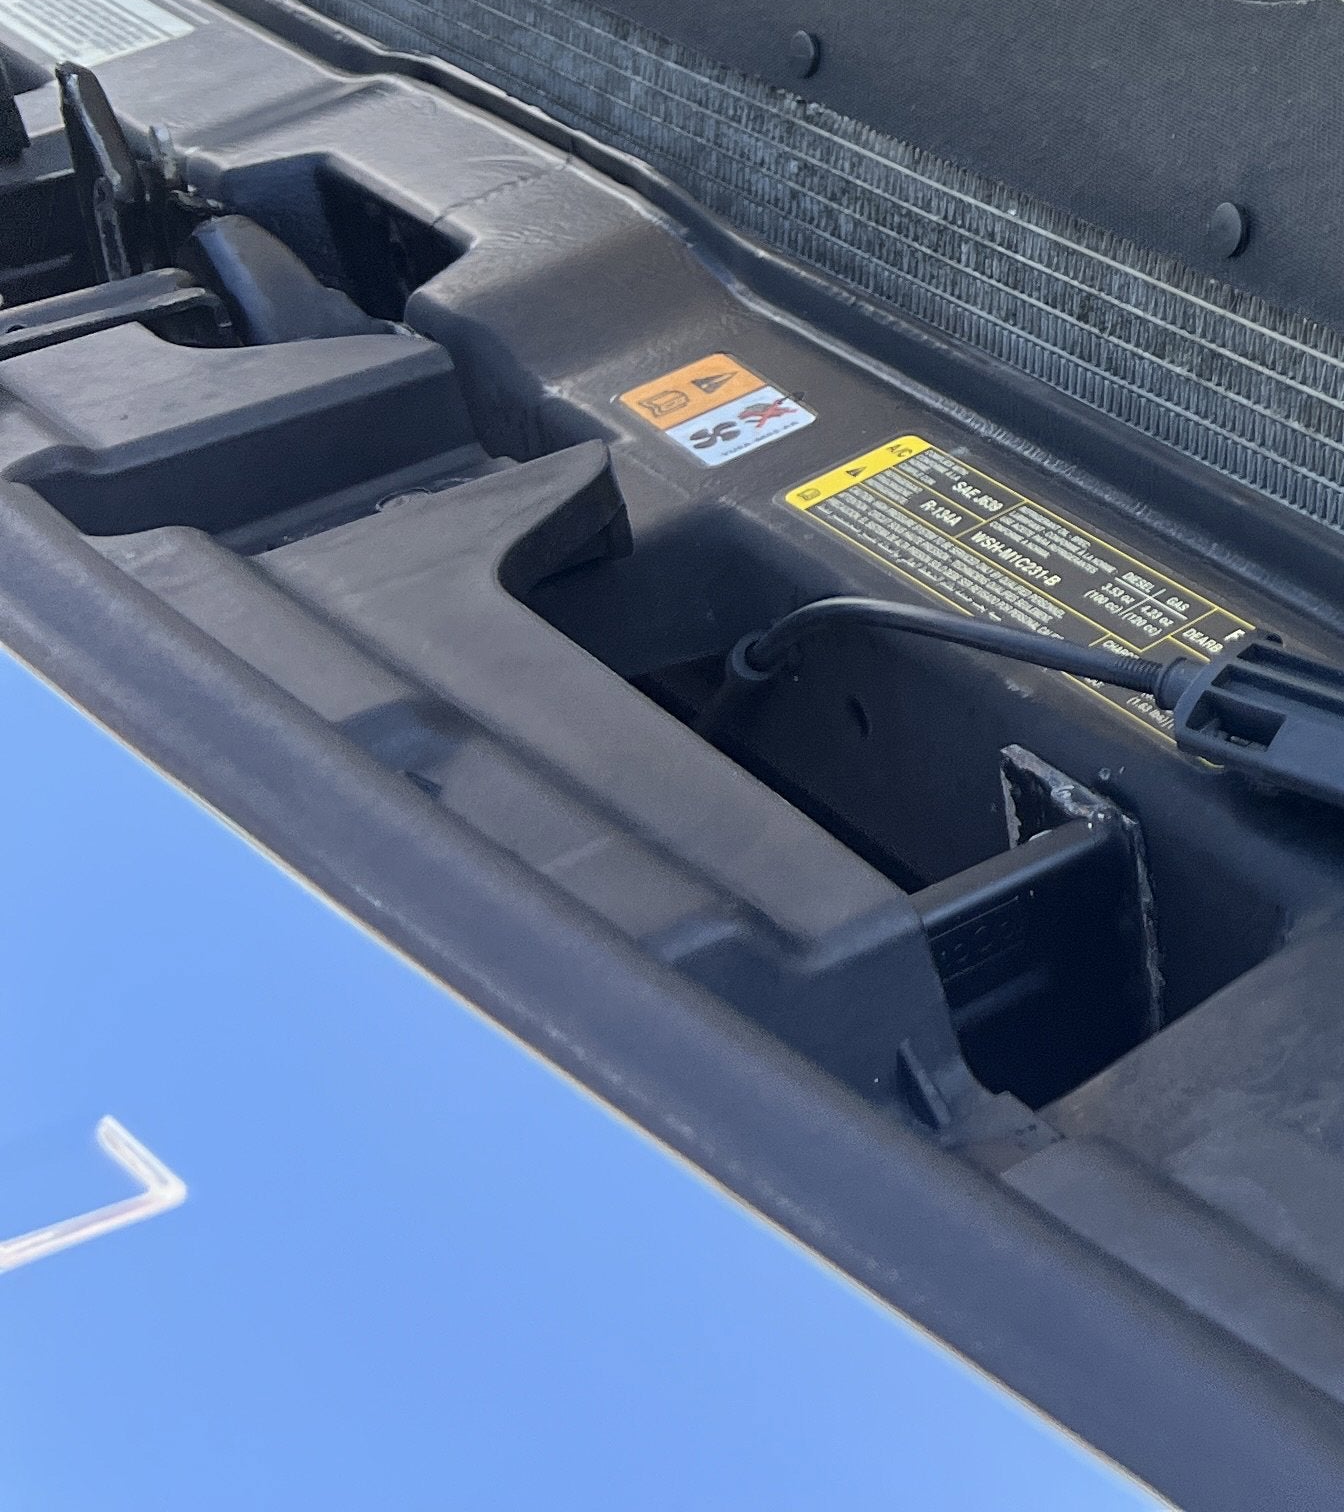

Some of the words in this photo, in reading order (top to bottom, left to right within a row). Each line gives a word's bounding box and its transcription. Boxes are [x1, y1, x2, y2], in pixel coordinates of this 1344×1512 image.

[886, 444, 912, 458] A/C
[952, 481, 979, 501] SAE
[920, 499, 963, 527] R-134A
[971, 531, 1062, 587] WSH-M1C231-B
[1122, 571, 1155, 593] DIESEL
[1166, 596, 1190, 612] GAS
